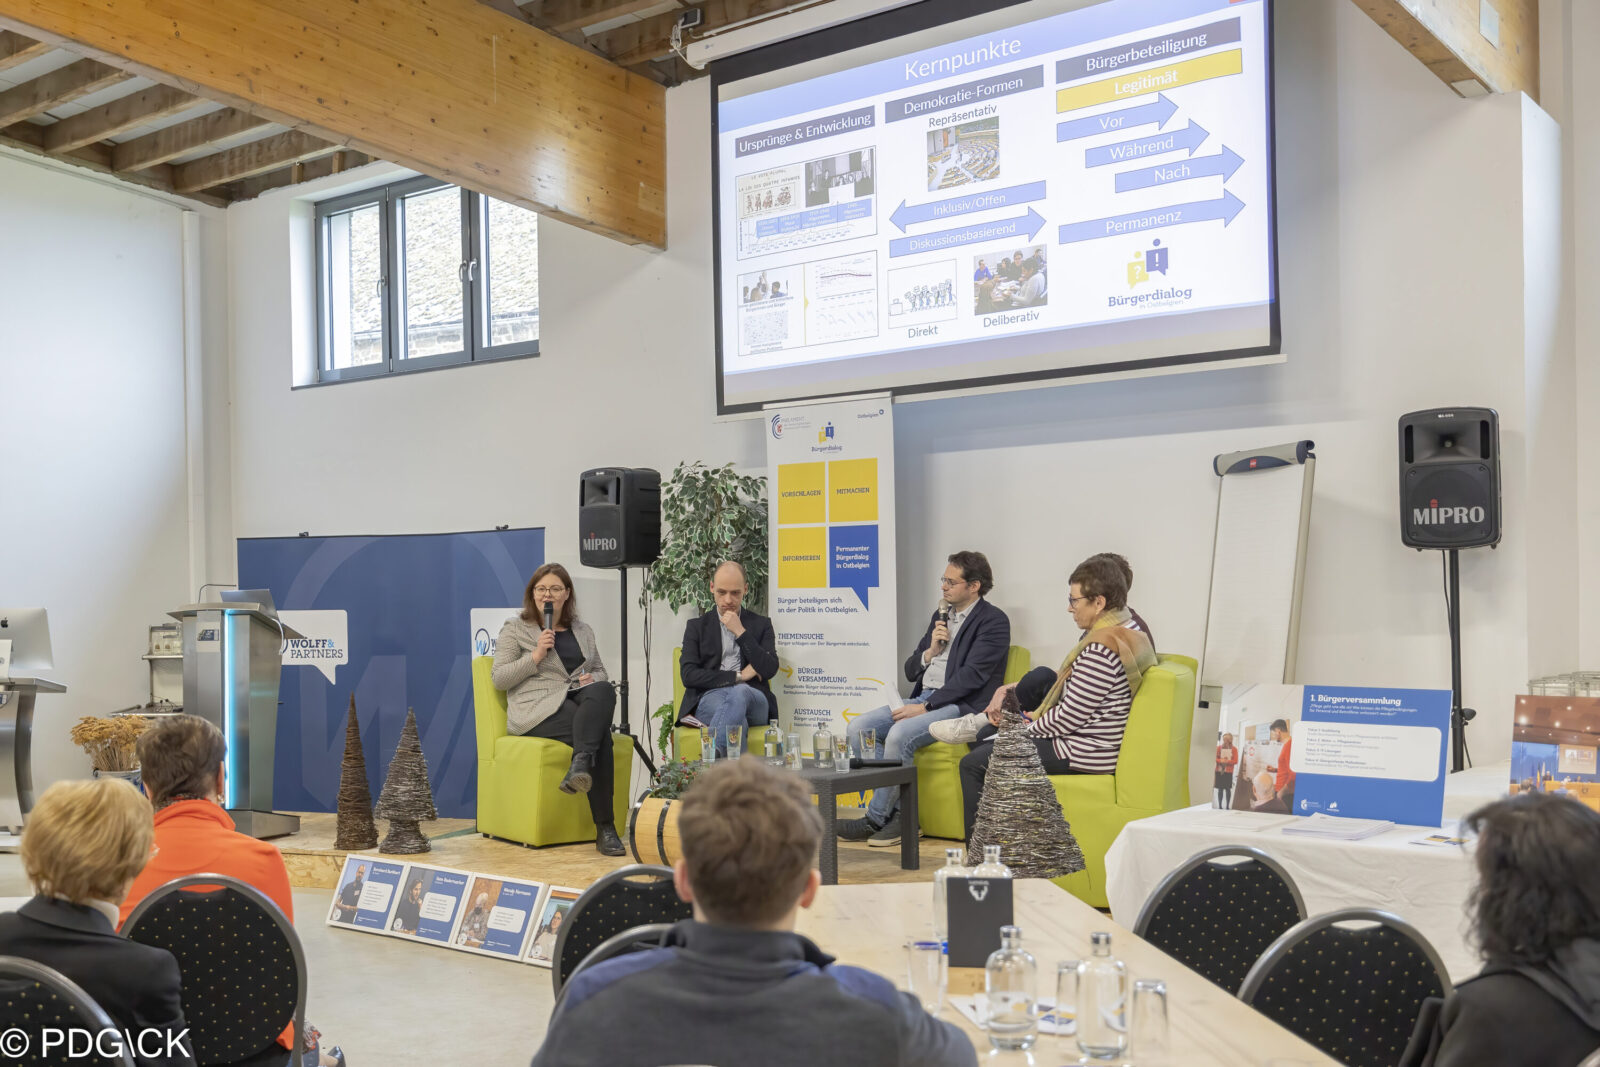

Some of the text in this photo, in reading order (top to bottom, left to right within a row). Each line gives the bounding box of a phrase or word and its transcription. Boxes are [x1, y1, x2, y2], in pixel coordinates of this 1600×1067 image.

[905, 38, 1022, 80] Kernpunkte
[1086, 33, 1208, 72] Bürgerbeteiligung
[1115, 70, 1179, 96] Legitimät
[904, 78, 1023, 115] Demokratie-Formen
[928, 105, 998, 128] Repräsentativ
[1100, 116, 1125, 130] Vor
[739, 113, 871, 153] Ursprünge & Entwicklung
[1110, 136, 1174, 160] Während
[1154, 165, 1190, 182] Nach
[934, 194, 1006, 217] Inklusiv/Offen
[1106, 211, 1182, 234] Permanenz
[909, 223, 1016, 251] Diskussionsbasierend
[1108, 287, 1193, 308] Bürgerdialog
[983, 310, 1040, 328] Deliberativ
[908, 325, 938, 339] Direkt
[782, 490, 821, 498] VORSCHLAGEN
[836, 487, 870, 495] MITMACHEN
[777, 596, 843, 605] Bürger beteiligen sich
[290, 649, 343, 660] PARTNERS
[798, 667, 825, 676] BÜRGER-
[798, 675, 847, 684] VERSAMMLUNG
[1311, 695, 1402, 707] 1. Bürgerversammlung
[794, 708, 831, 717] AUSTAUSCH
